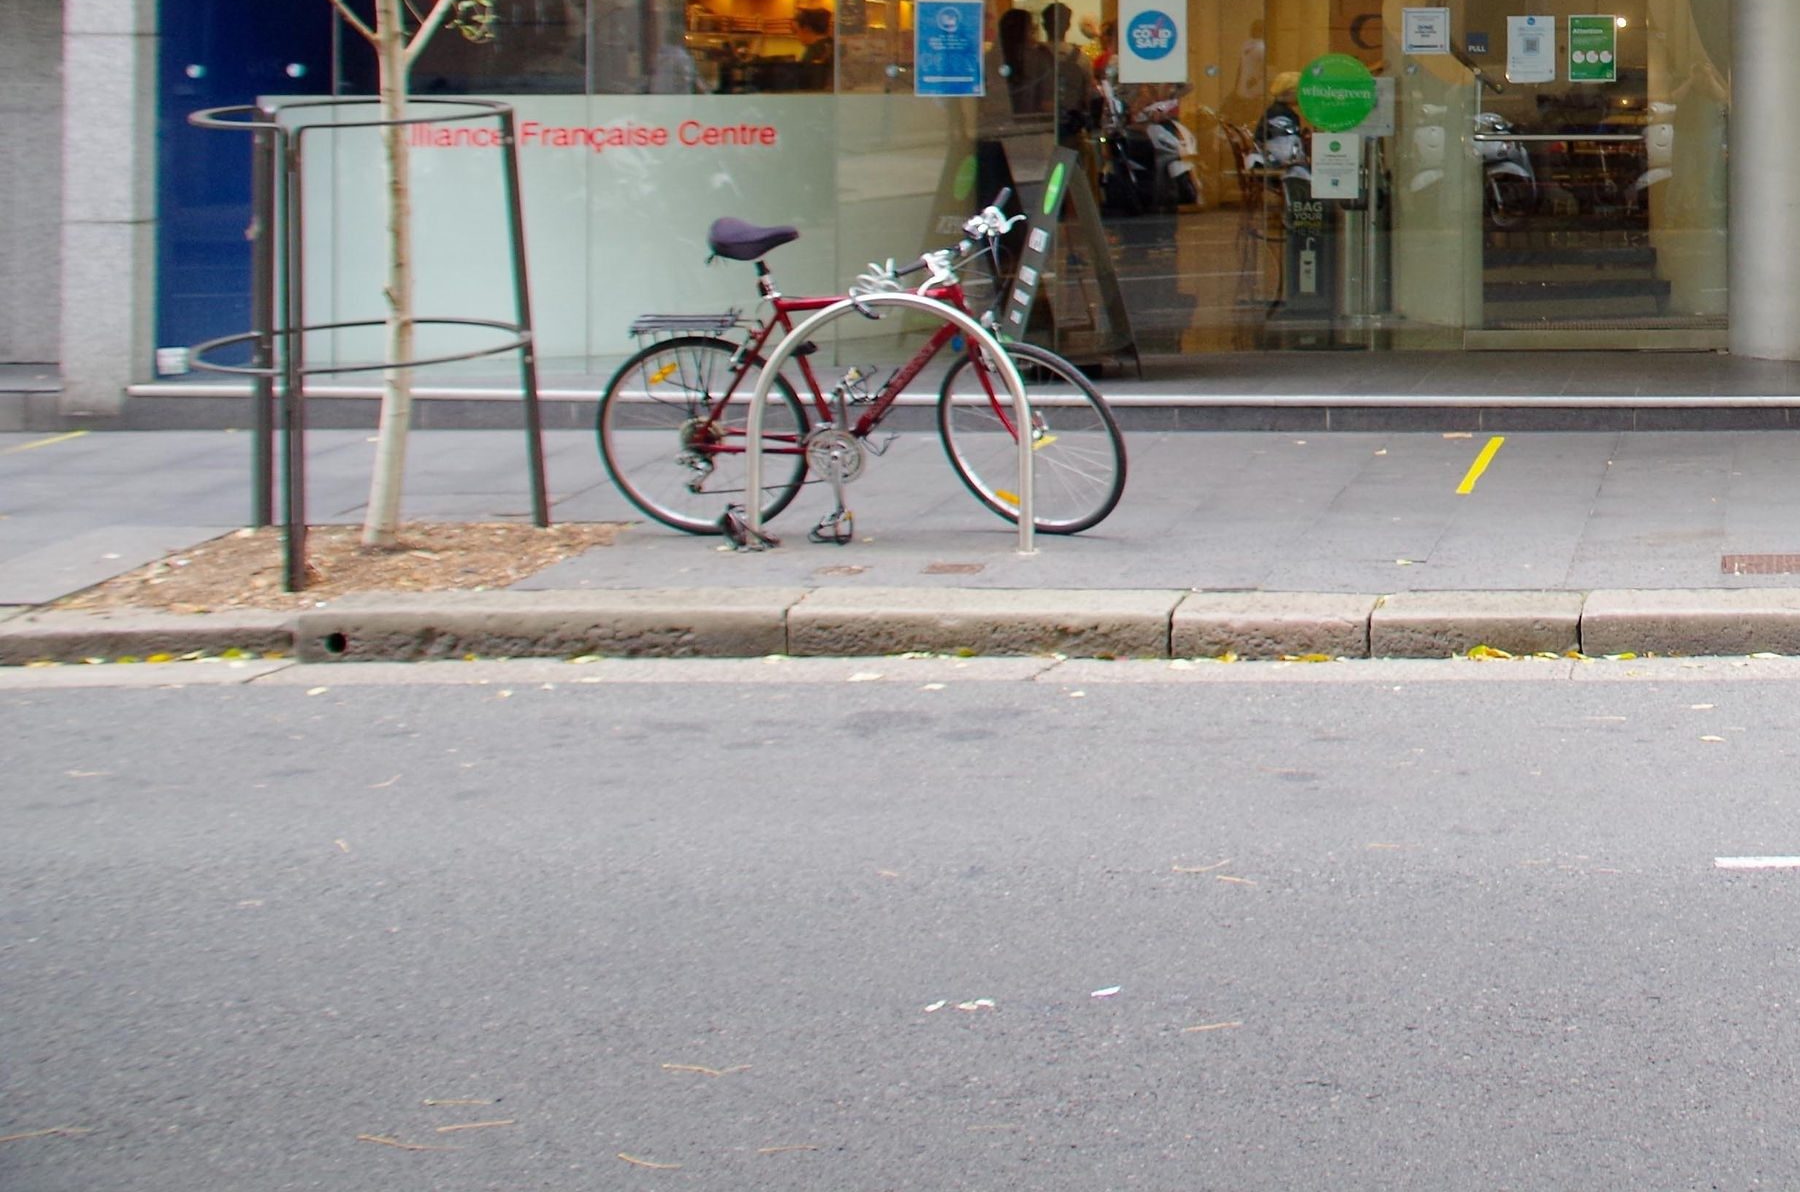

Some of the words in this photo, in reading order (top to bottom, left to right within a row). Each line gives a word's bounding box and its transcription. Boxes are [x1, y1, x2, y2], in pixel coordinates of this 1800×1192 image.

[1134, 38, 1169, 49] SAFE
[1467, 44, 1487, 53] PULL
[1302, 85, 1371, 100] wholegreen
[406, 121, 505, 148] lliance
[520, 121, 669, 153] Française
[677, 119, 777, 147] Centre
[1292, 200, 1323, 213] BAG
